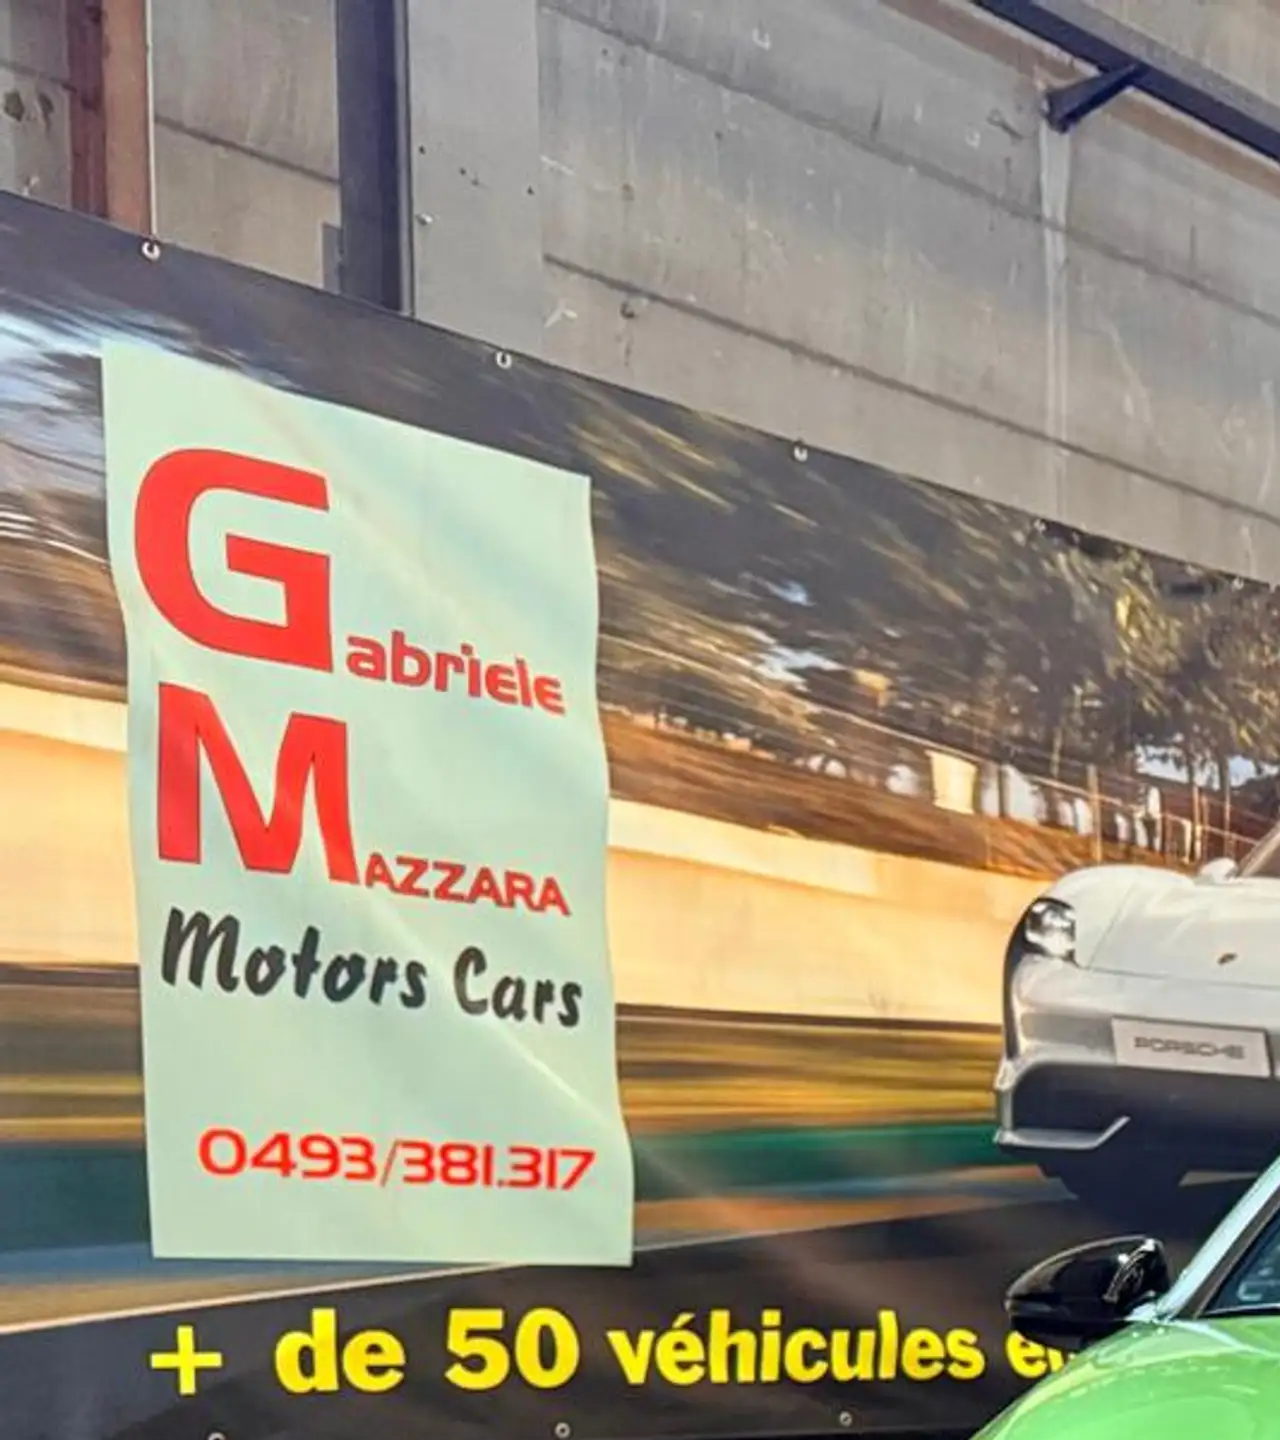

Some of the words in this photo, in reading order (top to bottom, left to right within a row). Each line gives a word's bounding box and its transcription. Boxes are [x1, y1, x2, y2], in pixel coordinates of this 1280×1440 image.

[161, 907, 427, 1009] Motors
[453, 945, 583, 1029] Cars
[1133, 1036, 1246, 1060] PORSCHE
[197, 1127, 596, 1192] 0493/381.317
[273, 1306, 407, 1393] de
[443, 1307, 581, 1391] 50
[606, 1308, 987, 1386] véhicules
